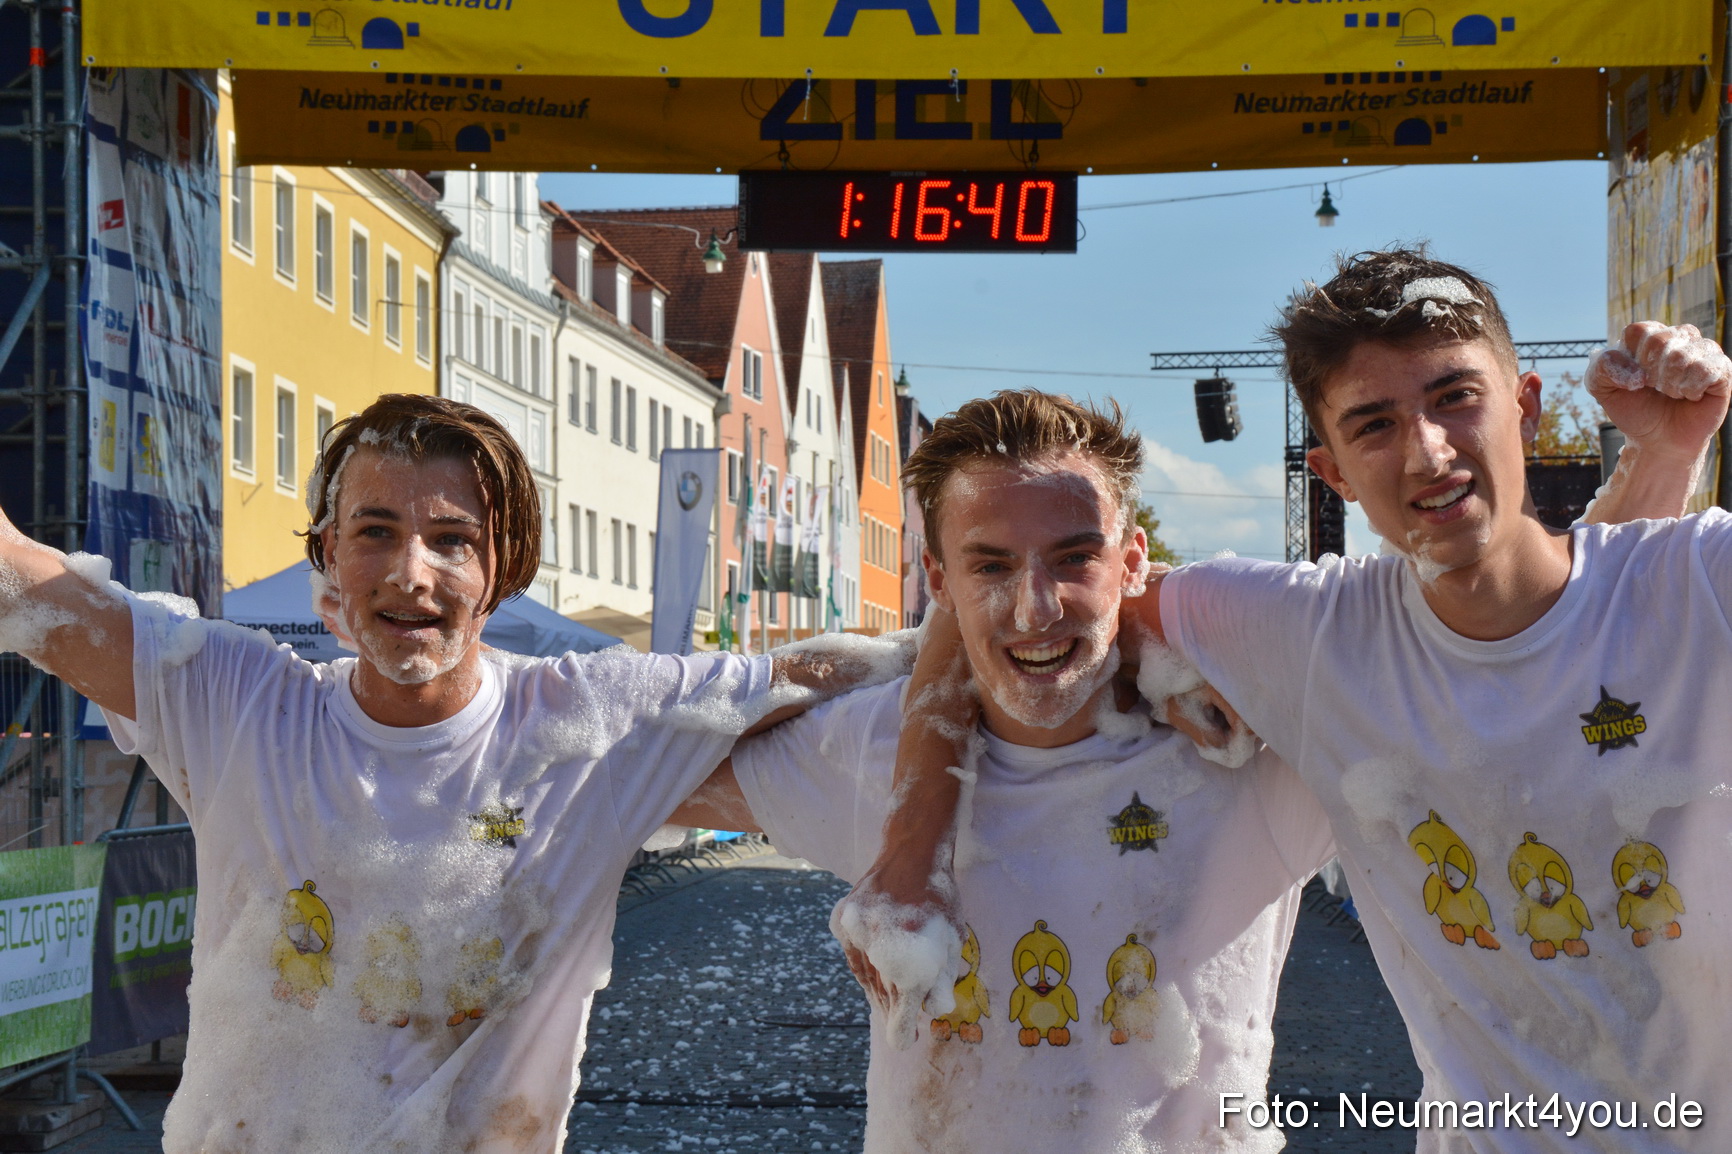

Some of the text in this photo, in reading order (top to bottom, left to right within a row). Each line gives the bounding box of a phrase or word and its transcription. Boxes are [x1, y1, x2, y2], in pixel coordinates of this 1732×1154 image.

[299, 87, 590, 120] Neumarkter Stadtlauf
[1233, 80, 1534, 114] Neumarkter Stadtlauf
[840, 180, 1055, 241] 1:16:40
[1582, 715, 1646, 744] WINGS
[1108, 821, 1168, 844] WINGS
